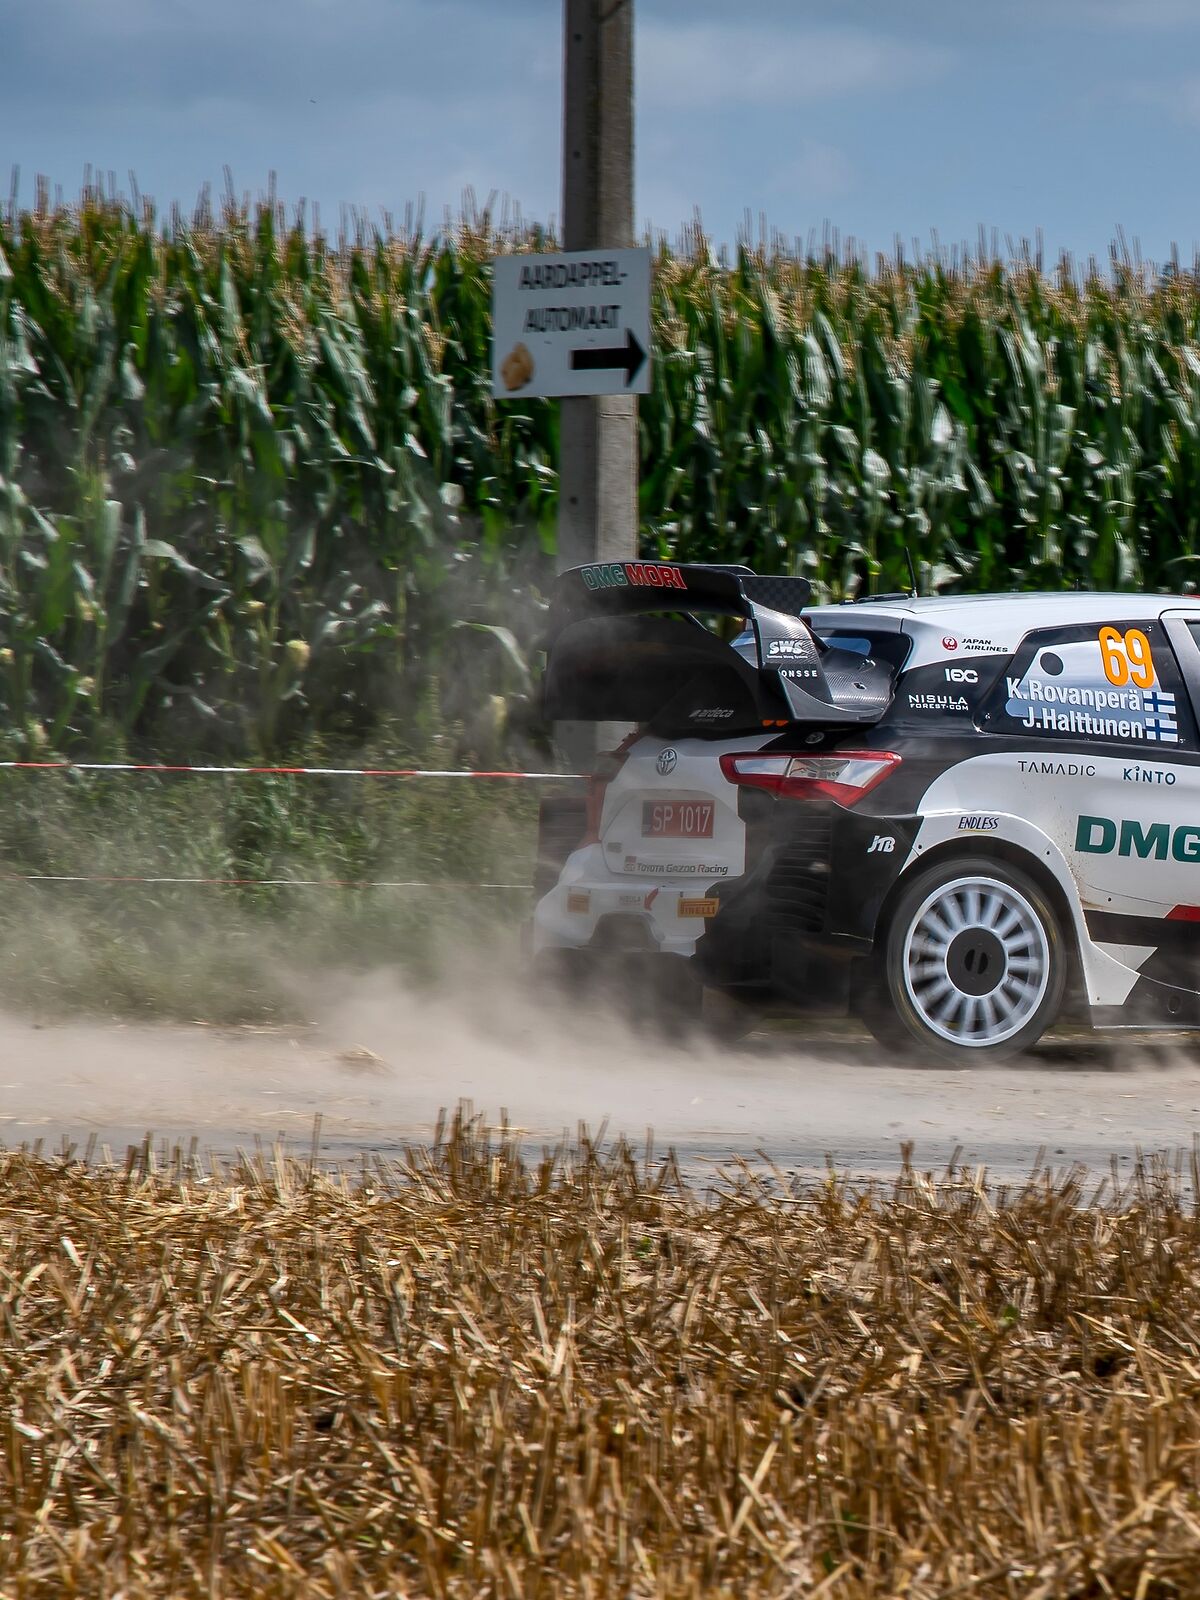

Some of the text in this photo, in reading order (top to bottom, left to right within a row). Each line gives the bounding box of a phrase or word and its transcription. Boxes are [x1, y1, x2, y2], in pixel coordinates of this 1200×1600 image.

[518, 261, 628, 290] AARDAPPEL-
[523, 304, 621, 333] AUTOMAAT
[581, 564, 688, 590] DMG MORI
[769, 640, 803, 654] SWS
[961, 638, 992, 646] JAPAN
[1099, 626, 1155, 688] 69
[781, 670, 818, 678] ONSSE
[908, 694, 968, 705] NISULA
[1018, 760, 1096, 777] TAMADIC
[653, 806, 711, 832] SP 1017
[958, 816, 999, 829] ENDLESS
[637, 863, 665, 873] TOYOTA
[697, 864, 729, 876] Racing
